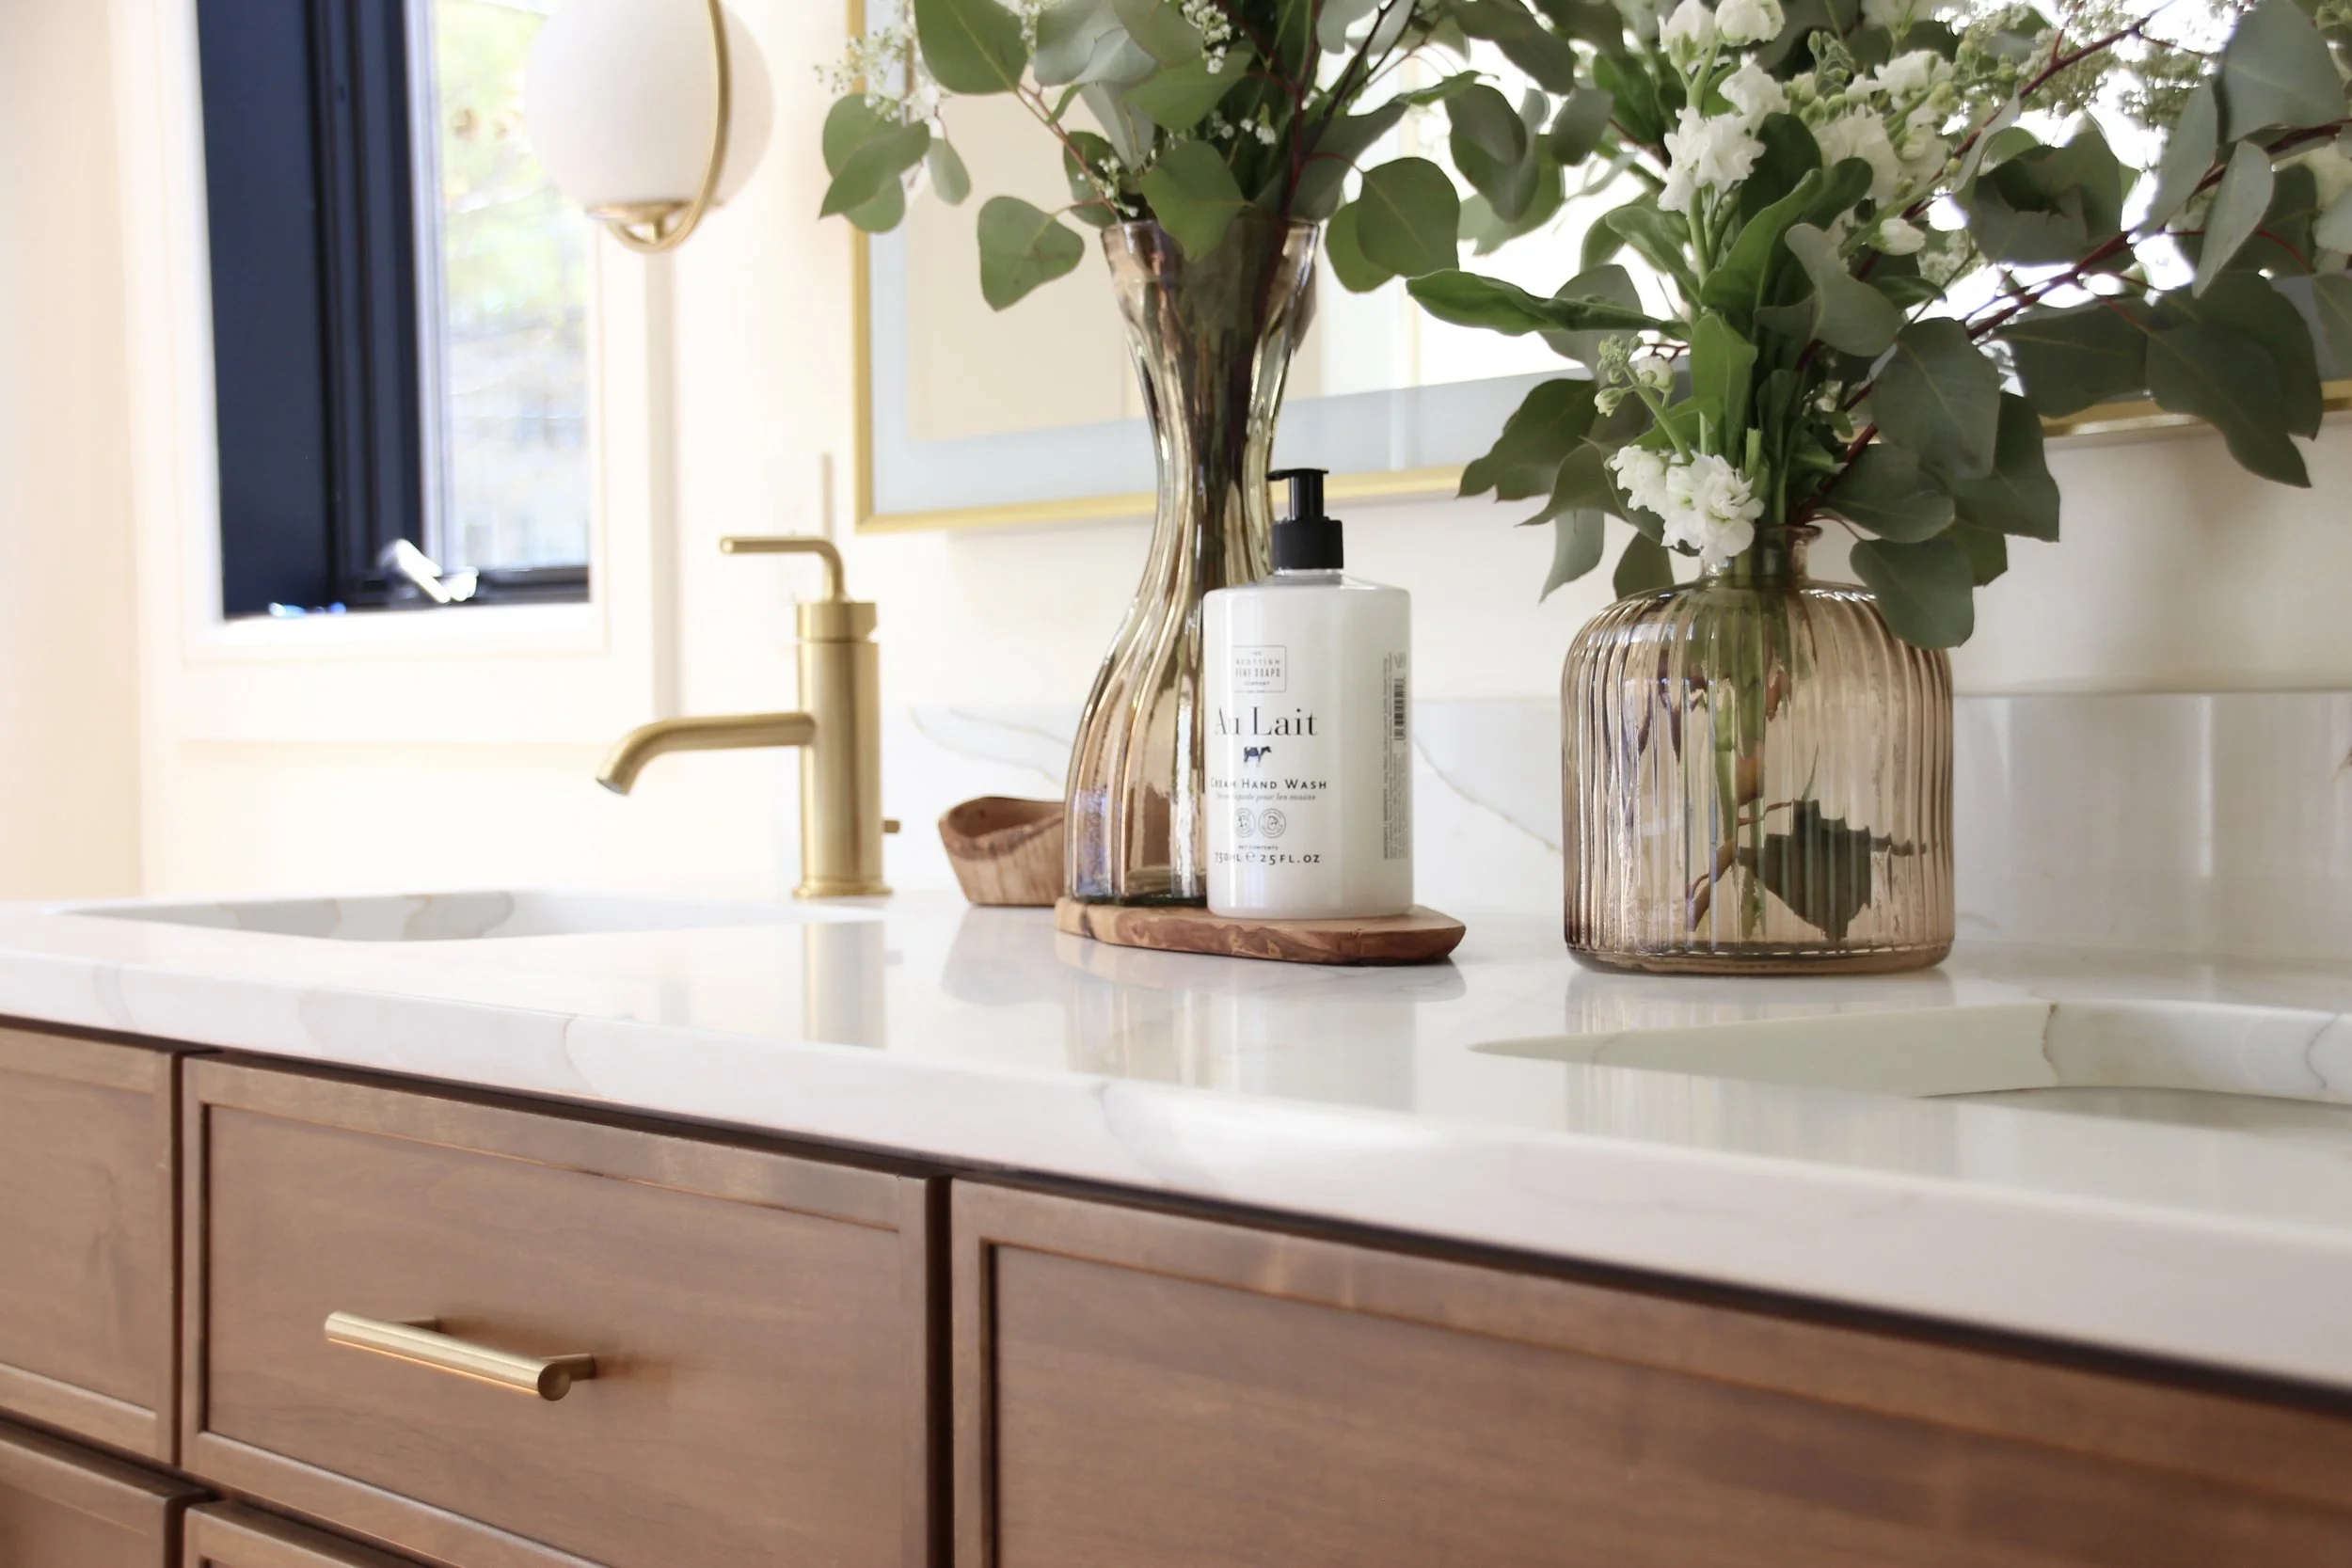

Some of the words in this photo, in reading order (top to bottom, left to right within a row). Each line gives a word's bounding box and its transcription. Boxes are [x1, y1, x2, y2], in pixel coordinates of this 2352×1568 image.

[1255, 668, 1280, 677] SOAPS
[1215, 706, 1241, 736] Au
[1250, 705, 1318, 736] Lait
[1241, 778, 1278, 789] HAND
[1284, 779, 1327, 789] WASH
